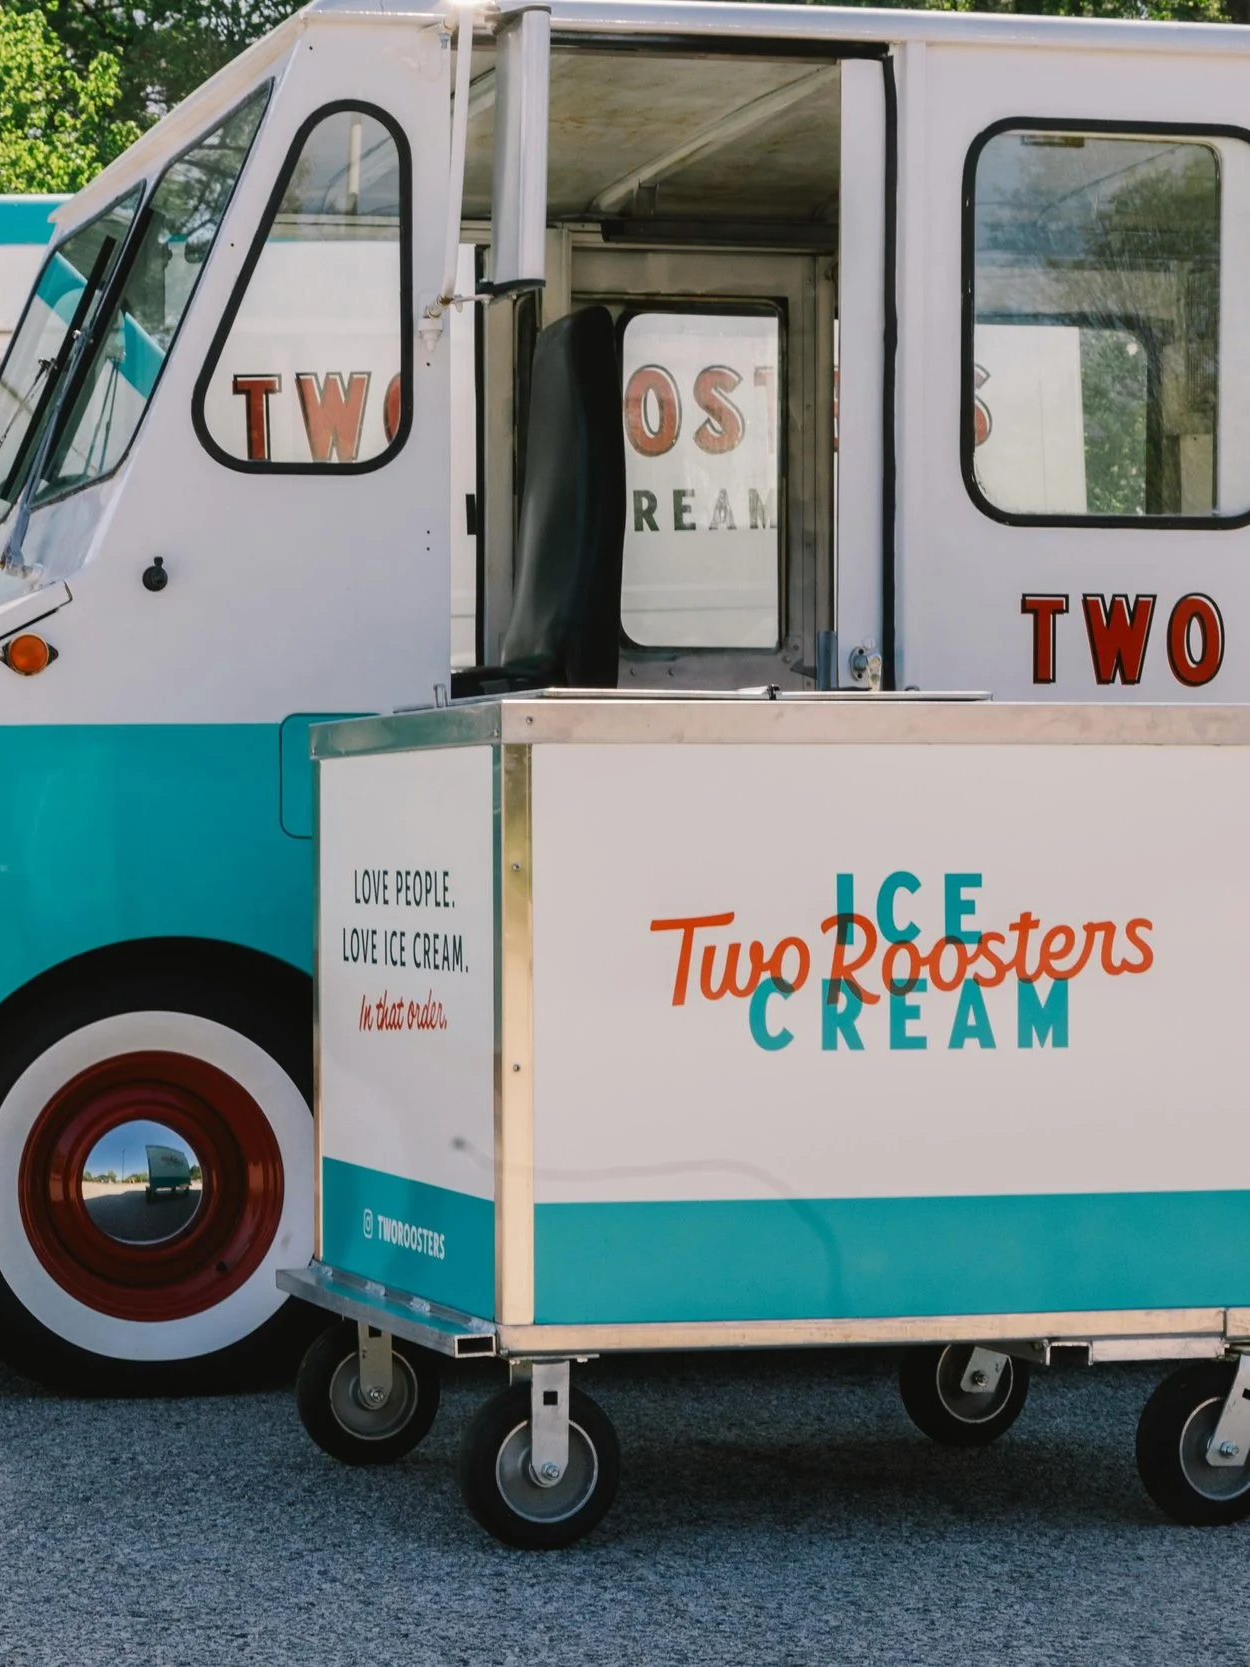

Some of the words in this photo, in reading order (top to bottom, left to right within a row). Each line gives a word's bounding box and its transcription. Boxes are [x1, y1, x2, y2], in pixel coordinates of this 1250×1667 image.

[632, 488, 778, 532] REAM
[1021, 592, 1225, 687] TWO
[354, 869, 389, 905] LOVE
[395, 870, 455, 908] PEOPLE.
[835, 870, 983, 945] ICE
[343, 927, 378, 964] LOVE
[384, 930, 406, 967] ICE
[413, 931, 469, 973] CREAM.
[650, 911, 811, 1006] Two
[820, 911, 1155, 1006] Roosters
[359, 993, 373, 1032] In
[375, 989, 405, 1032] that
[407, 988, 448, 1031] order.
[748, 976, 1070, 1052] CREAM
[377, 1214, 445, 1261] TWOROOSTERS
